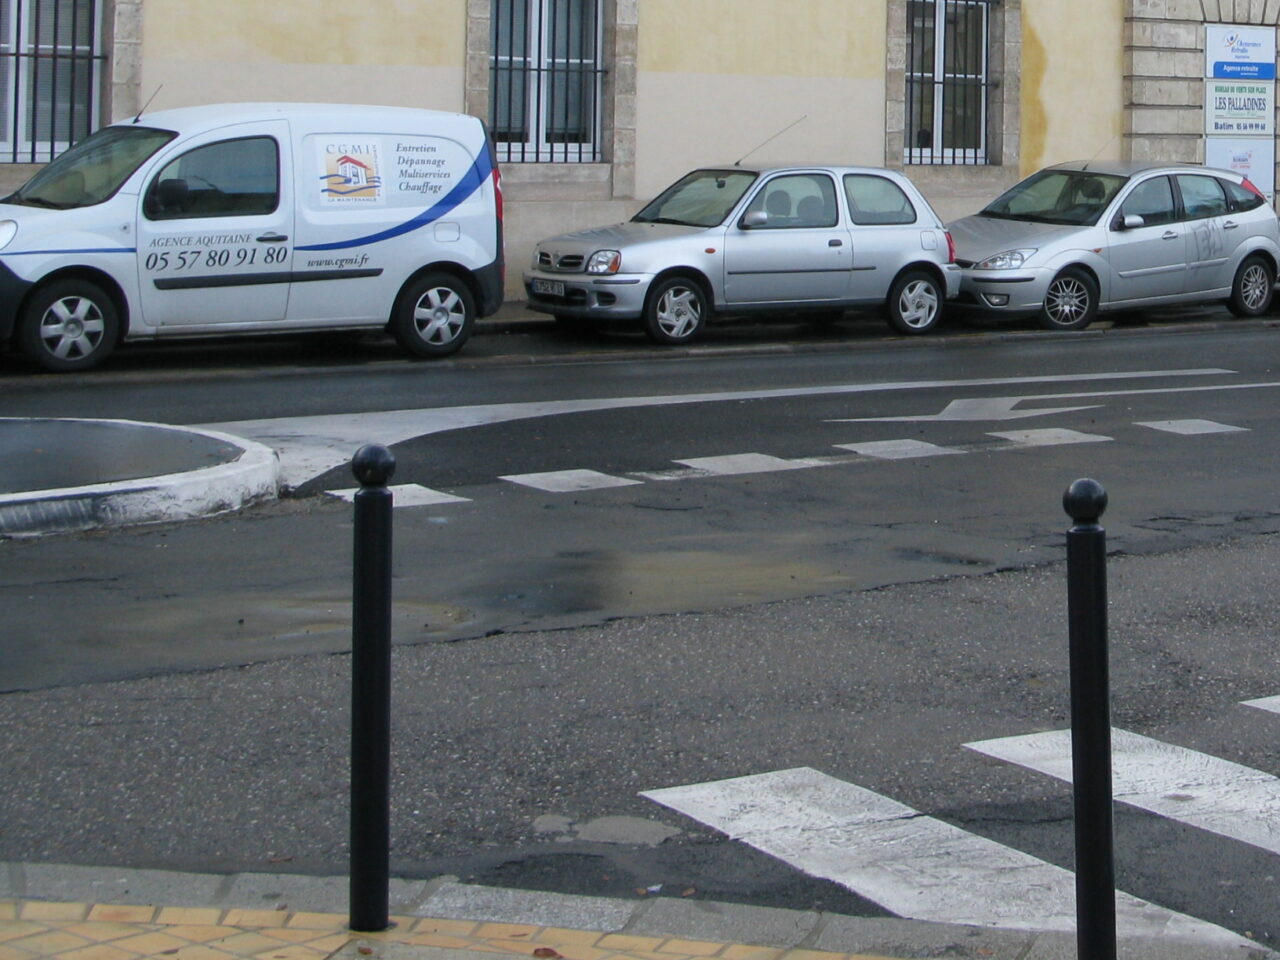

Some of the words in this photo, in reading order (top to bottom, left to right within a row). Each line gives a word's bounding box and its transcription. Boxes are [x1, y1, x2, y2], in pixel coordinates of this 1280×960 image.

[1215, 96, 1227, 110] LES
[1228, 97, 1267, 111] PALLADINES
[1214, 122, 1234, 130] Batim
[396, 143, 437, 153] Entretien
[397, 156, 446, 166] Dépannage
[399, 169, 451, 179] Multiservices
[399, 182, 443, 193] Chauffage
[150, 237, 192, 248] AGENCE
[195, 234, 252, 246] AQUITAINE
[145, 251, 170, 271] 05
[174, 250, 202, 270] 57
[205, 249, 230, 267] 80
[234, 247, 257, 266] 91
[264, 246, 288, 264] 80
[307, 253, 370, 268] www.cgmi.fr
